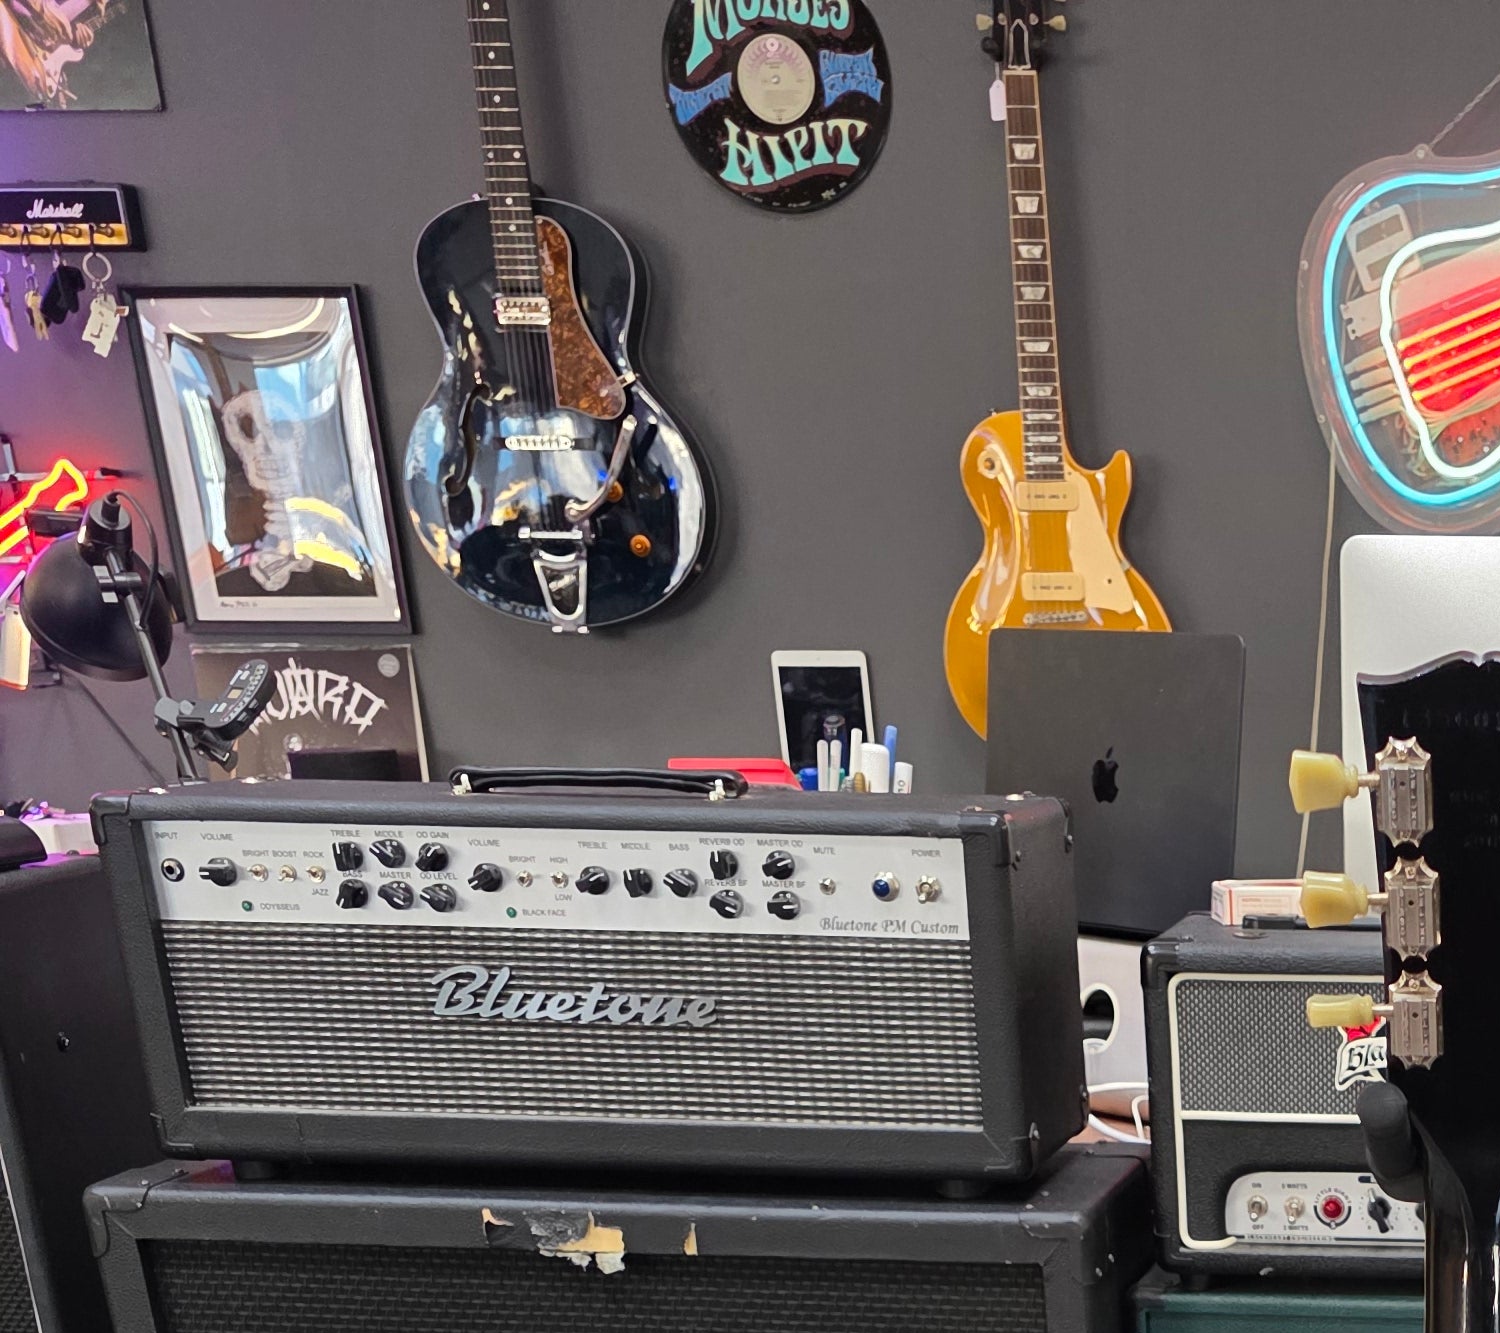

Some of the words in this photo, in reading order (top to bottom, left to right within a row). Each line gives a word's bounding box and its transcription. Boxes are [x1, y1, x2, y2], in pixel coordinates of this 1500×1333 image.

[719, 117, 869, 187] HIPIT
[26, 198, 84, 219] Marshall
[154, 831, 178, 840] INPUT
[200, 833, 234, 841] VOLUME
[330, 829, 361, 838] TREBLE
[374, 830, 404, 838] MIDDLE
[467, 839, 501, 847] VOLUME
[577, 841, 608, 850] TREBLE
[620, 842, 652, 850] MIDDLE
[699, 837, 732, 846] REVERB
[757, 839, 789, 848] MASTER
[668, 843, 690, 851] BASS
[813, 847, 836, 855] MUTE
[272, 850, 297, 858] BOOST
[911, 849, 942, 858] POWER
[508, 855, 536, 863] BRIGHT
[549, 856, 568, 864] HIGH
[379, 871, 412, 880] MASTER
[434, 872, 458, 880] LEVEL
[704, 879, 736, 888] REVERB
[762, 880, 795, 889] MASTER
[311, 888, 330, 896] JAZZ
[555, 893, 573, 901] LOW
[521, 908, 546, 916] BLACK
[548, 909, 567, 917] FACE
[819, 916, 879, 932] Bluetone
[881, 919, 907, 933] PM
[910, 919, 960, 935] Custom
[431, 964, 718, 1028] Bluetone
